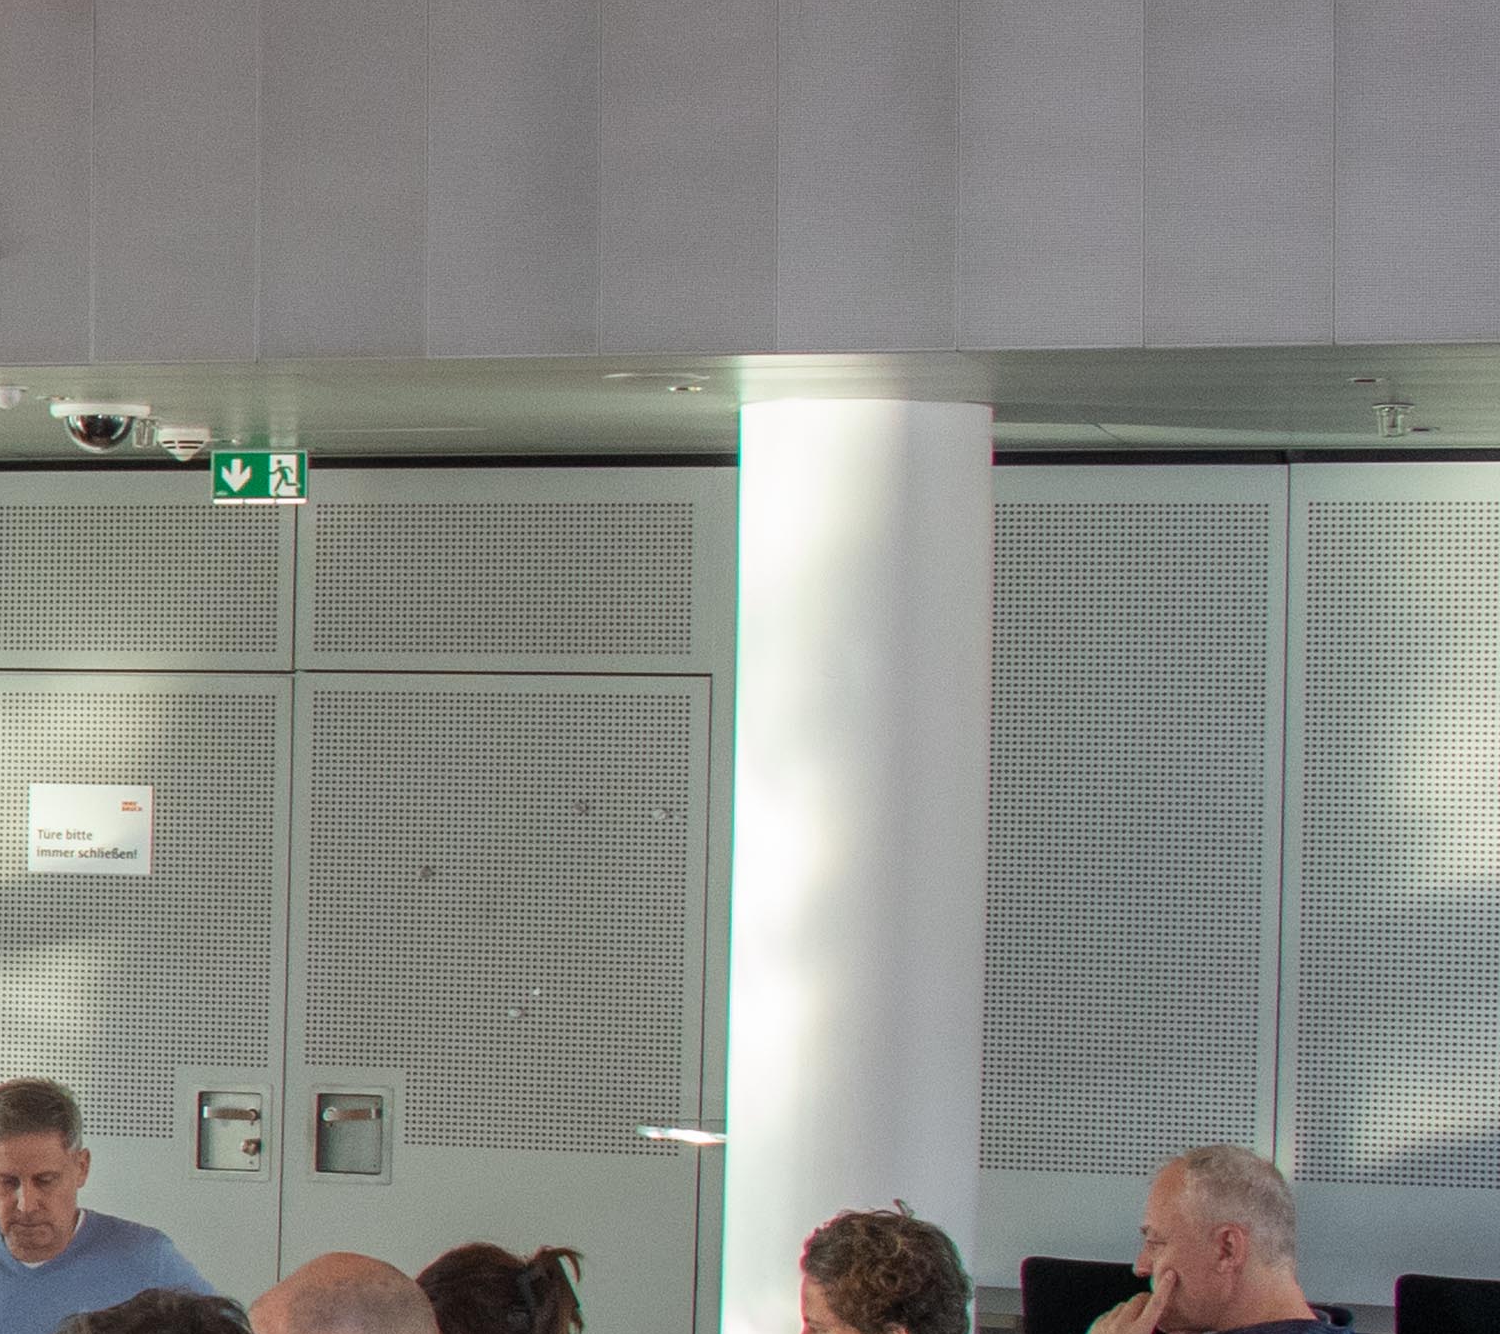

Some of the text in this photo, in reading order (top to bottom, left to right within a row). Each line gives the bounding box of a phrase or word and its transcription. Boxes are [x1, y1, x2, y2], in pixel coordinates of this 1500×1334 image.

[65, 829, 93, 840] bitte
[36, 846, 138, 860] immer schließen!
